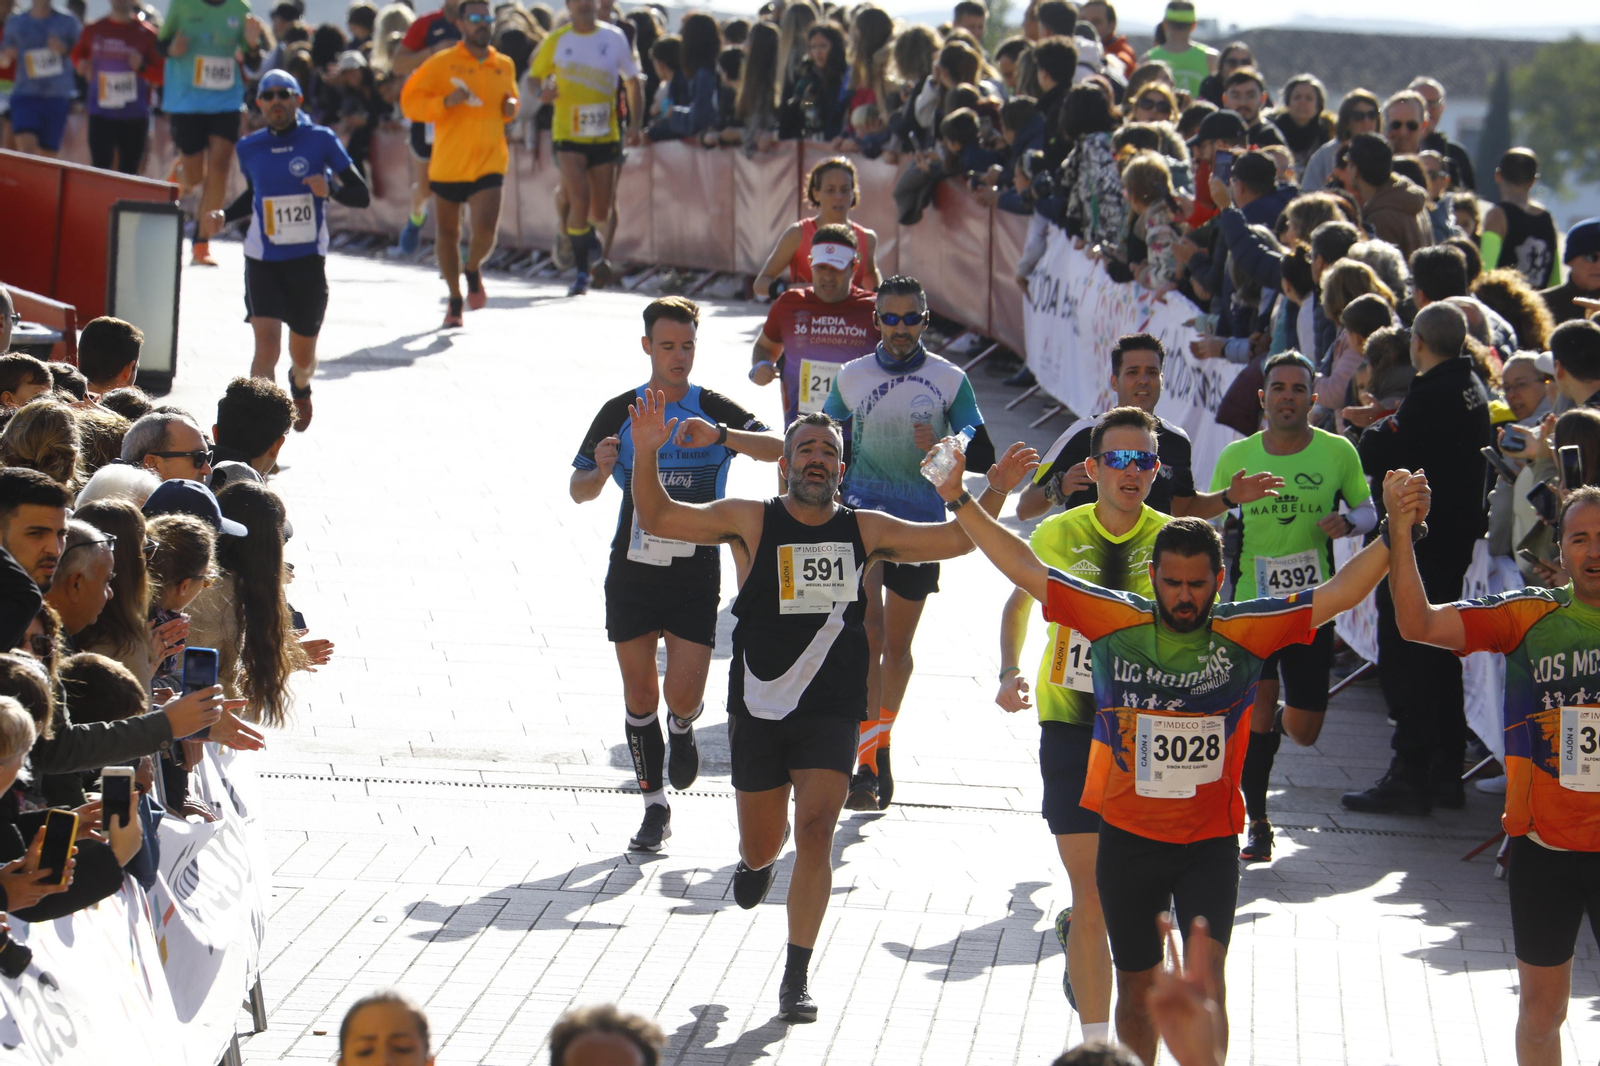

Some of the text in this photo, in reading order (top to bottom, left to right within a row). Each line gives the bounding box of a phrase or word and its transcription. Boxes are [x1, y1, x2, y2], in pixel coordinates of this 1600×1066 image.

[276, 205, 311, 222] 1120
[794, 324, 867, 337] 36 MARATÓN
[811, 316, 846, 326] MEDIA
[675, 449, 710, 460] TRIATLÓN
[1250, 503, 1323, 515] MARBELLA
[803, 545, 832, 553] IMDECO
[803, 557, 844, 581] 591
[1269, 564, 1319, 589] 4392
[1055, 646, 1064, 671] CAJÓN
[1531, 652, 1565, 683] LOS
[1163, 720, 1199, 729] IMDECO
[1153, 734, 1220, 762] 3028
[1566, 734, 1574, 761] CAJÓN
[1580, 726, 1600, 755] 3
[1140, 741, 1148, 767] CAJÓN
